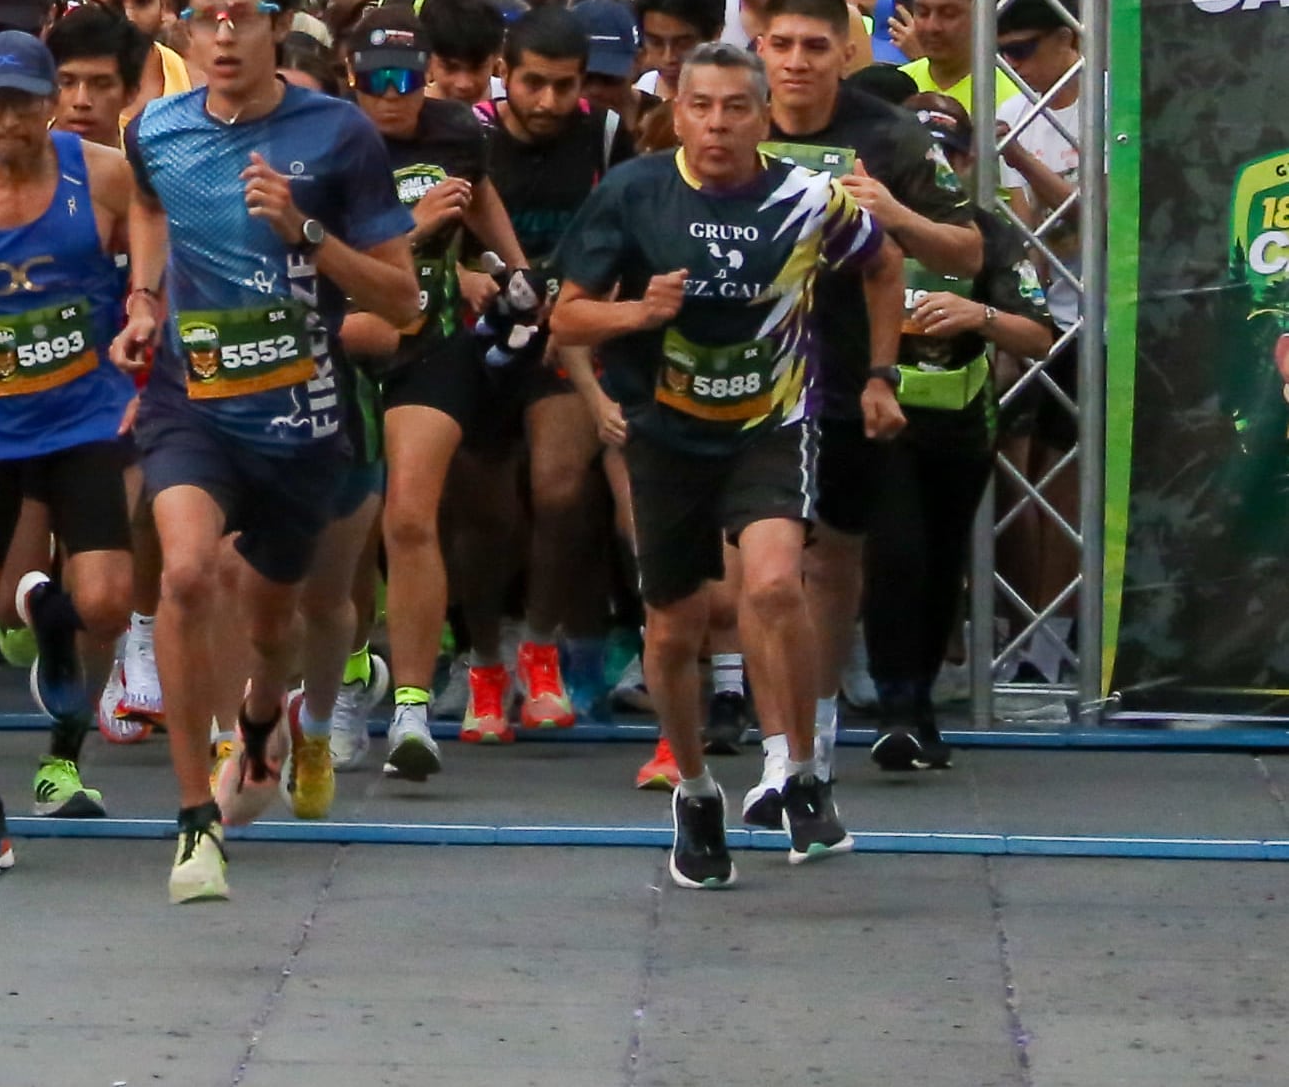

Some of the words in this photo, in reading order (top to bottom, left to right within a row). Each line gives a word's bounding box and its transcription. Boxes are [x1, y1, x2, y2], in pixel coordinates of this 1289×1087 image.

[689, 222, 759, 241] GRUPO
[17, 331, 84, 366] 5893
[221, 335, 299, 369] 5552
[693, 372, 760, 398] 5888
